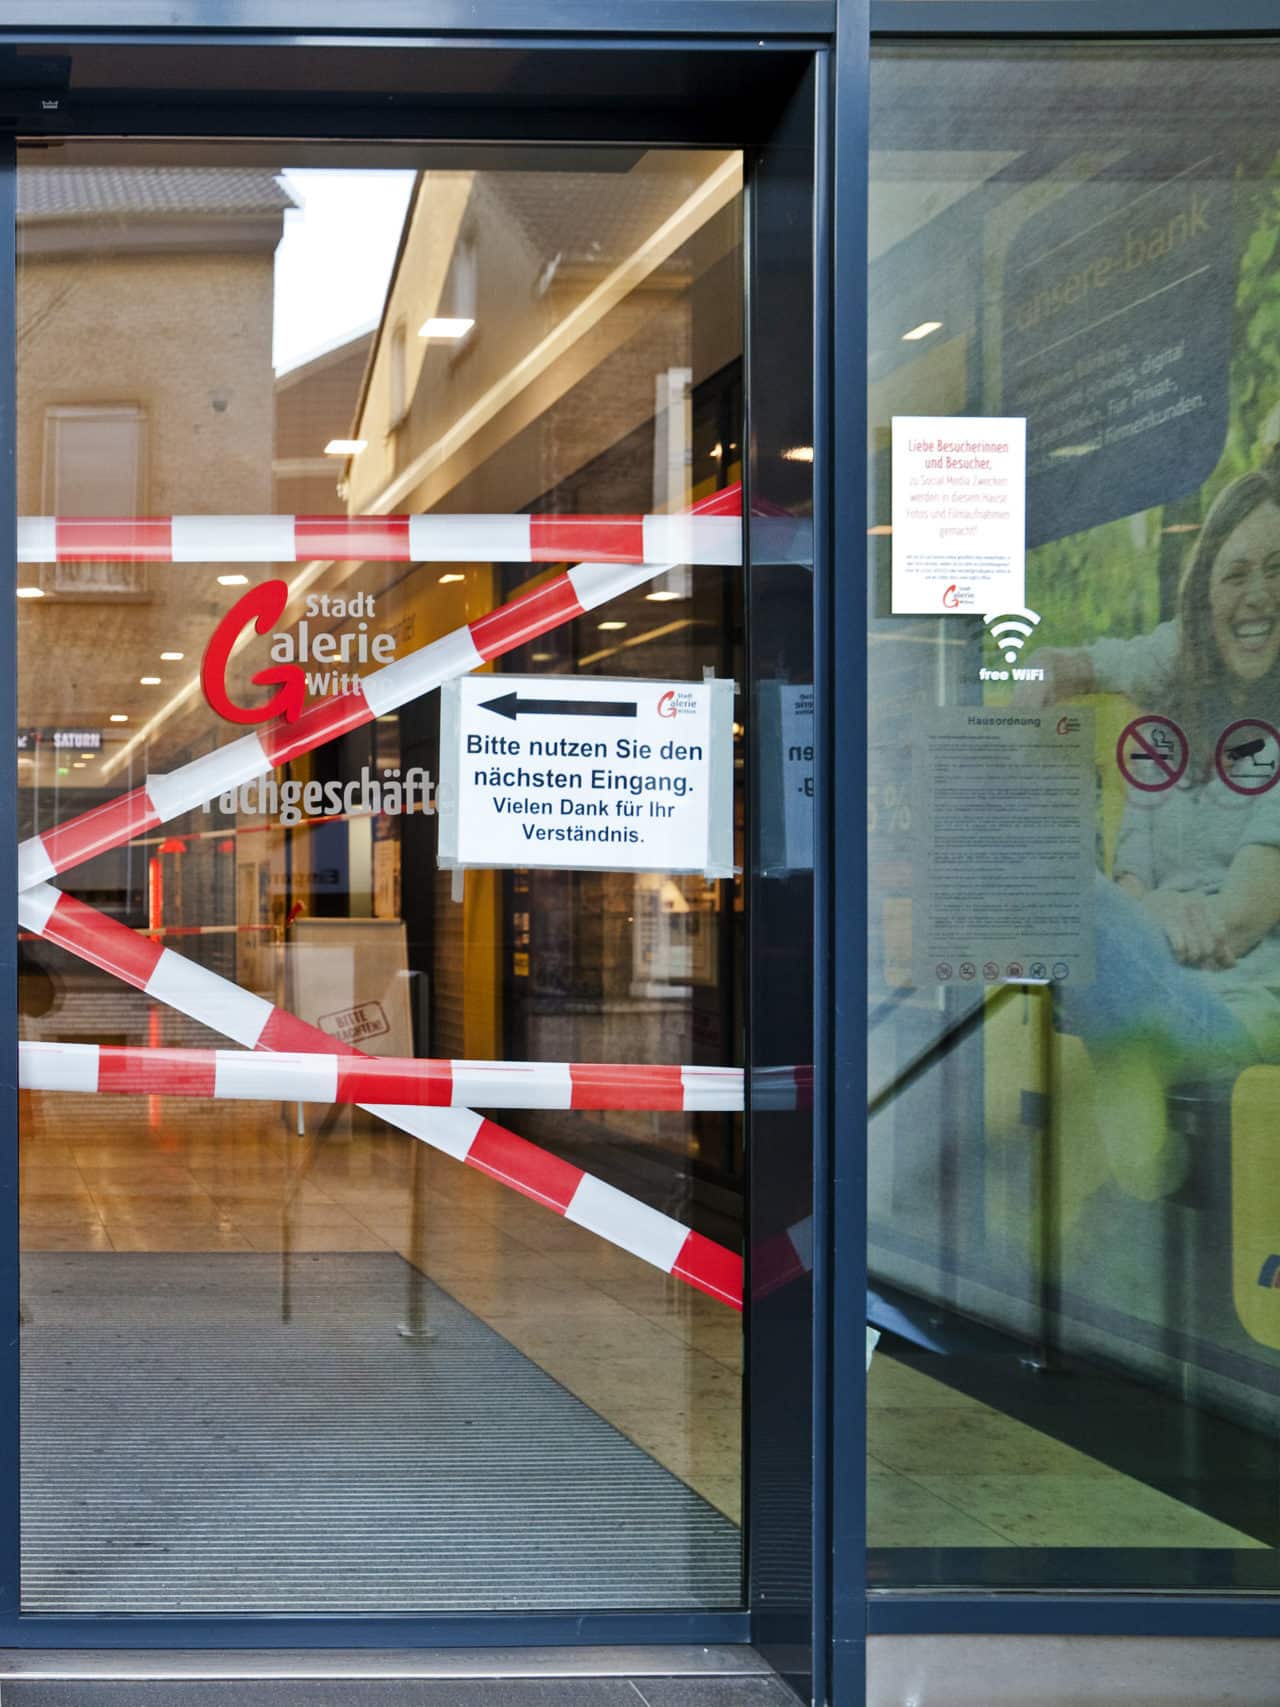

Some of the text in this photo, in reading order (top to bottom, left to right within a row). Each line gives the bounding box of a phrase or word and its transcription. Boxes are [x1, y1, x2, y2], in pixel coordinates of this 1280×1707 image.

[908, 439, 1009, 453] Liebe Besucherinnen
[925, 456, 992, 471] und Besucher,
[306, 592, 376, 618] Stadt
[979, 668, 1009, 681] free
[968, 716, 1041, 728] Hausordnung
[467, 734, 703, 760] Bitte nutzen Sie den
[474, 767, 694, 796] nächsten Eingang.
[493, 797, 676, 818] Vielen Dank für Ihr
[522, 823, 644, 843] Verständnis.
